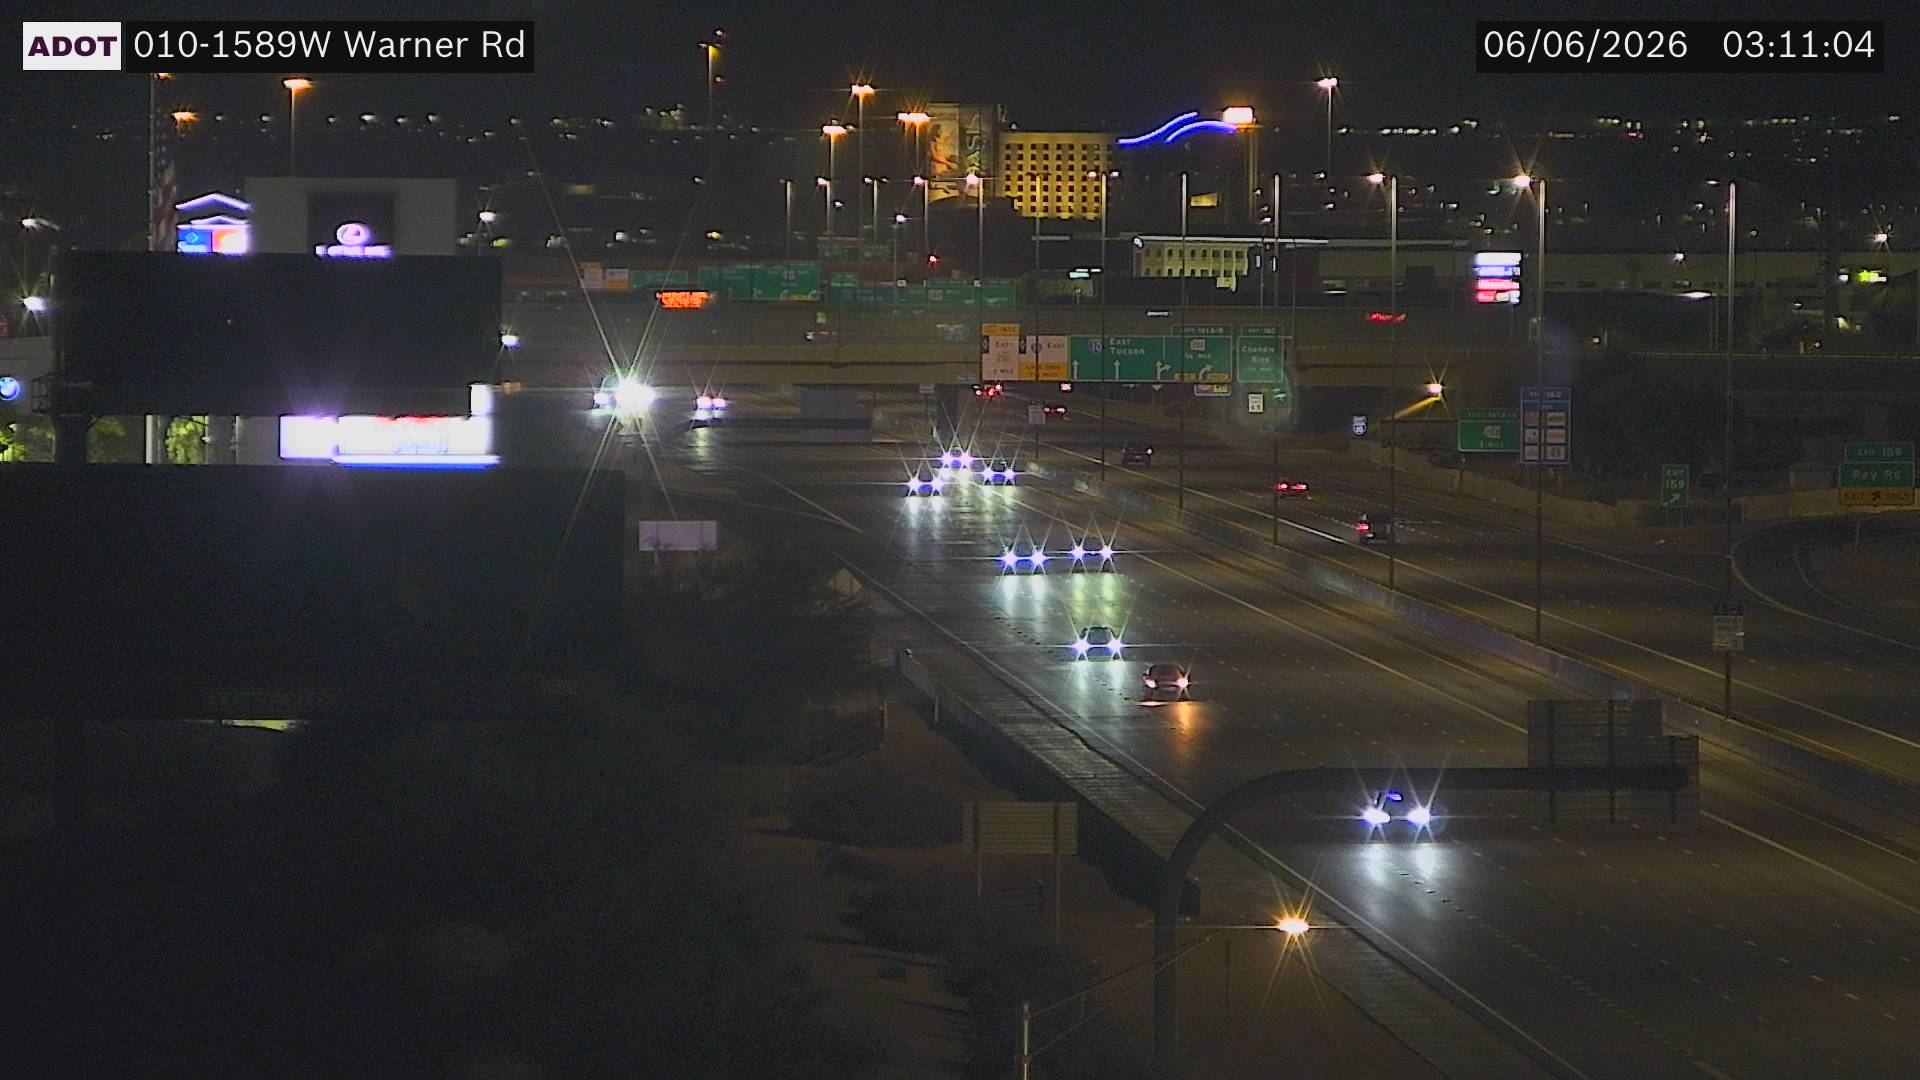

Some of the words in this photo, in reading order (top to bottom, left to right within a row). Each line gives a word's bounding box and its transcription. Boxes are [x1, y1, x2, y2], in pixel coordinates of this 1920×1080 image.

[1852, 469, 1877, 481] Ray
[1884, 469, 1902, 480] Rd
[1665, 479, 1686, 489] 159
